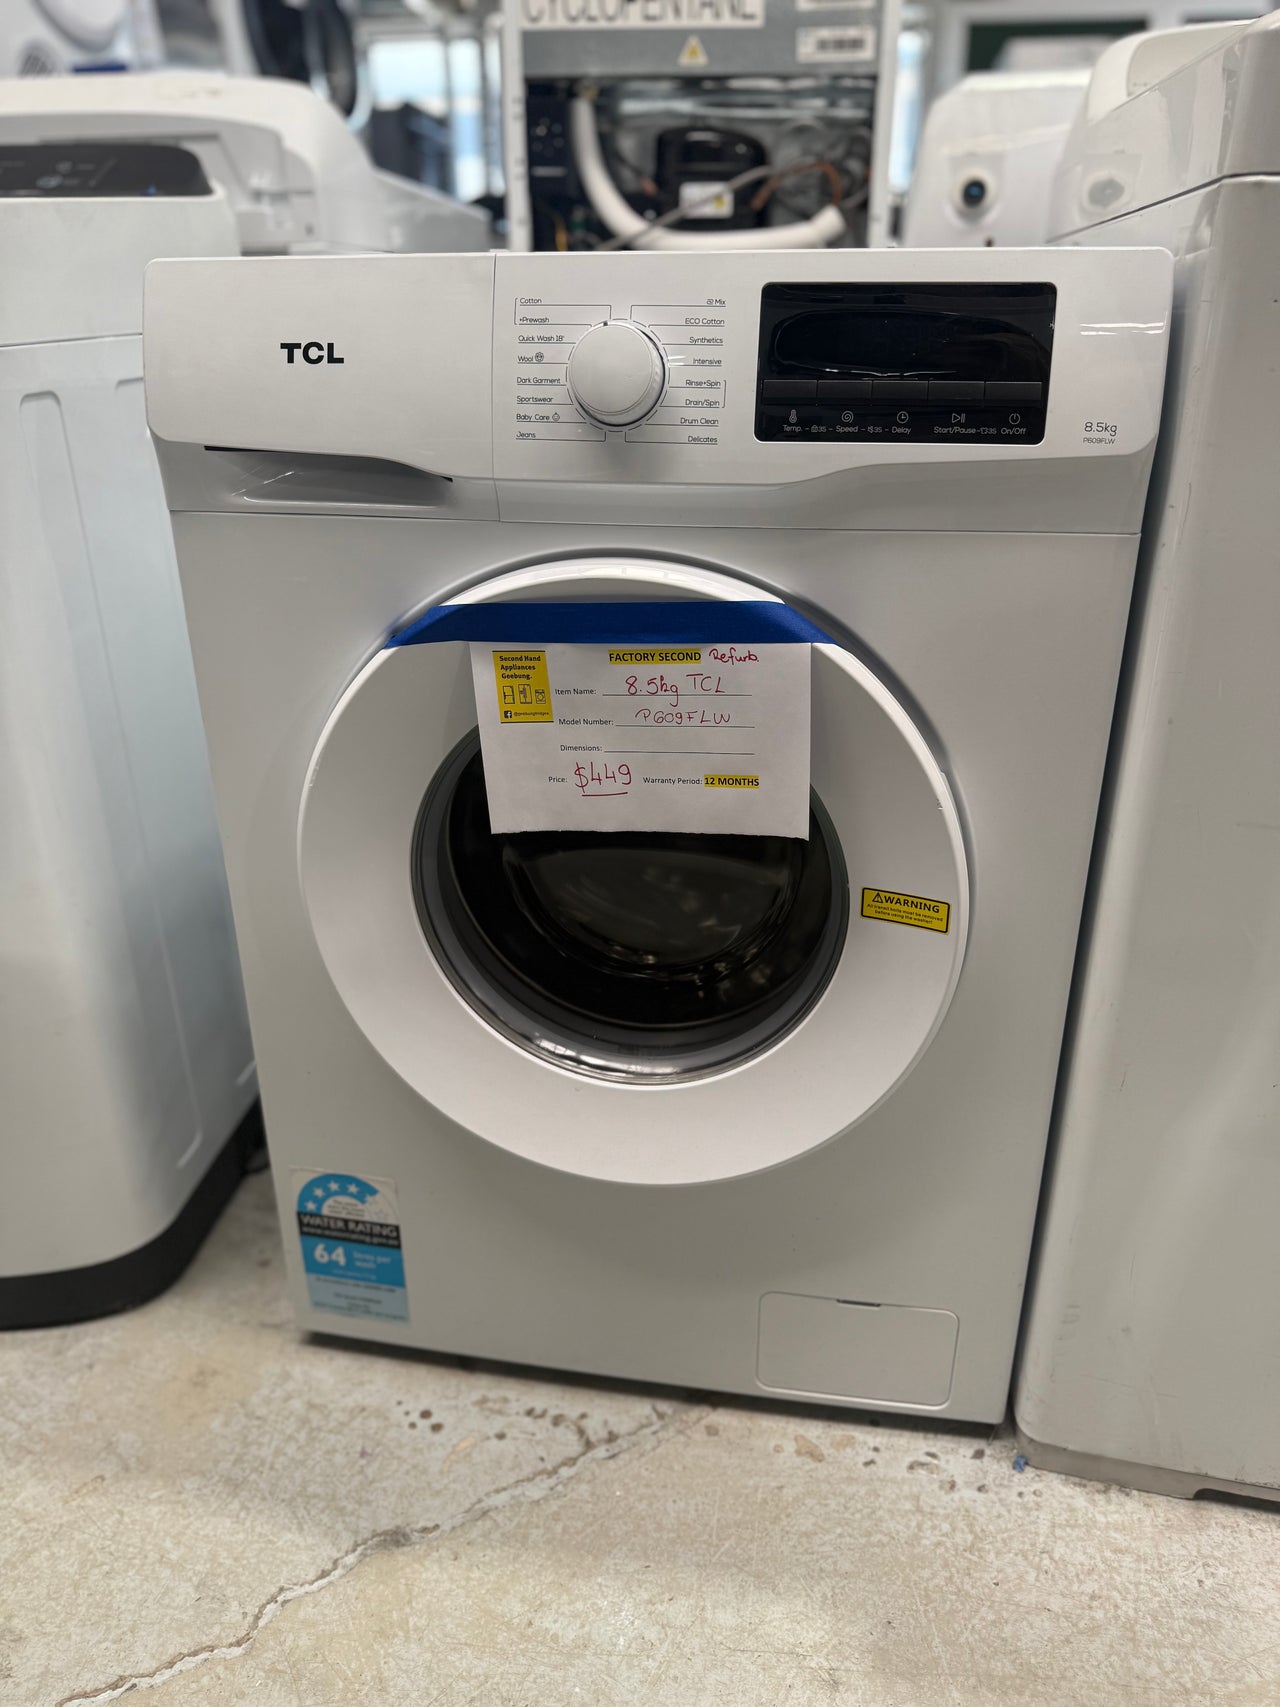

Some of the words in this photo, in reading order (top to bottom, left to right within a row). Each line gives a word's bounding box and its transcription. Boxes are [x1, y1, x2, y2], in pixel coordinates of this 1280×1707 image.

[685, 317, 701, 325] ECO
[701, 317, 725, 325] Cotton
[689, 336, 724, 344] Synthetics
[280, 341, 345, 365] TCL
[516, 395, 554, 403] Sportswear
[685, 399, 720, 407] Drain/Spin
[516, 413, 532, 422] Baby
[534, 413, 550, 421] Care
[700, 417, 719, 425] Clean
[836, 425, 859, 433] Speed
[891, 426, 912, 434] Delay
[934, 426, 976, 434] Start/Pause
[1000, 427, 1027, 435] On/Off
[1084, 421, 1118, 437] 8.5kg
[1083, 437, 1116, 445] P609FLW
[609, 652, 656, 662] FACTORY
[658, 651, 702, 662] SECOND
[625, 674, 679, 707] 8.5kg
[686, 673, 726, 693] TCL
[558, 718, 582, 726] Model
[560, 744, 603, 752] Dimensions:
[574, 762, 632, 793] $449
[643, 777, 675, 785] Warranty
[704, 777, 716, 786] 12
[717, 777, 760, 787] MONTHS
[884, 895, 940, 914] WARNING
[301, 1213, 346, 1230] WATER
[347, 1220, 398, 1237] RATING
[314, 1243, 347, 1267] 64
